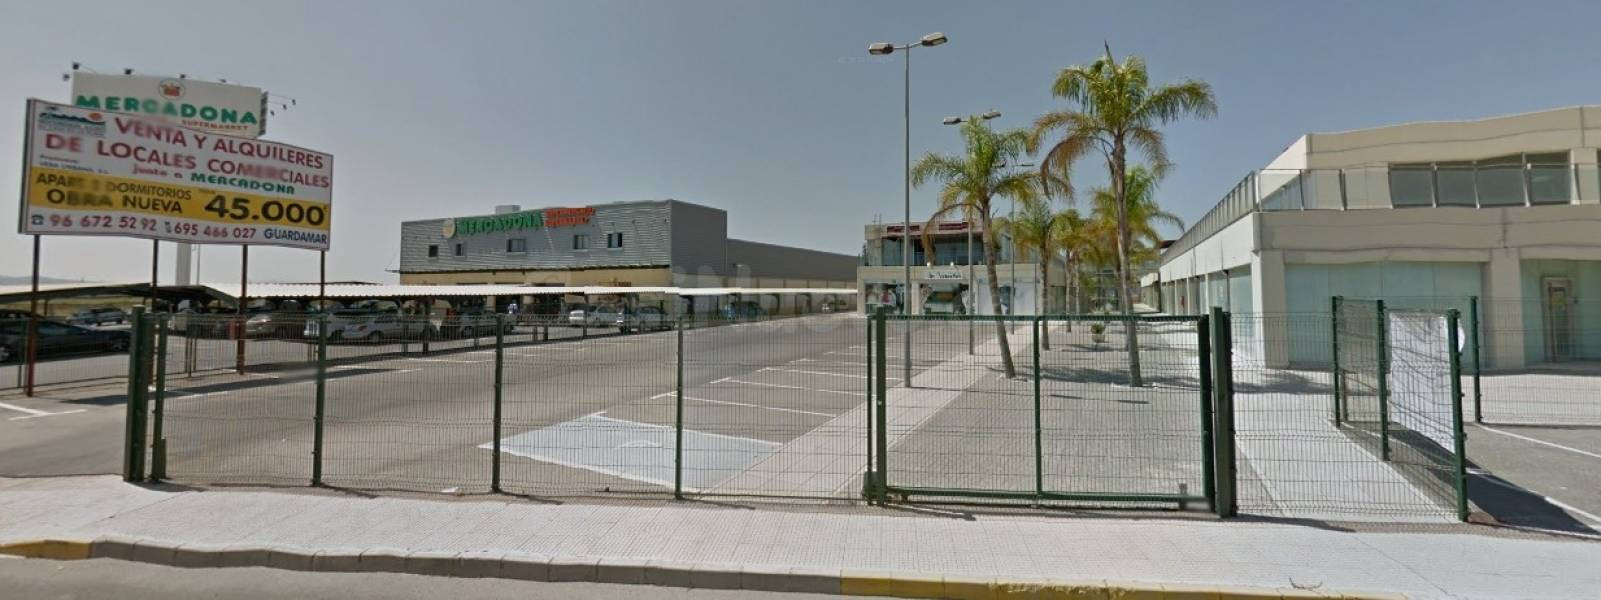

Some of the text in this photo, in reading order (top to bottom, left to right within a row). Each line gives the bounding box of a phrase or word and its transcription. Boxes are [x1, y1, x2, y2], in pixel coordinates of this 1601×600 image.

[76, 95, 257, 126] MERCADONA
[45, 133, 82, 153] DE
[97, 139, 197, 171] LOCALES
[115, 117, 324, 170] VENTA Y ALQUILERES
[106, 180, 193, 201] DORMITORIOS
[190, 172, 295, 195] MERCADONA
[122, 194, 184, 214] NUEVA
[49, 214, 73, 228] 96
[79, 214, 113, 229] 672
[118, 216, 137, 230] 52
[141, 217, 158, 232] 92
[174, 223, 199, 236] 695
[233, 227, 257, 240] 027
[263, 227, 328, 245] GUARDAMAR
